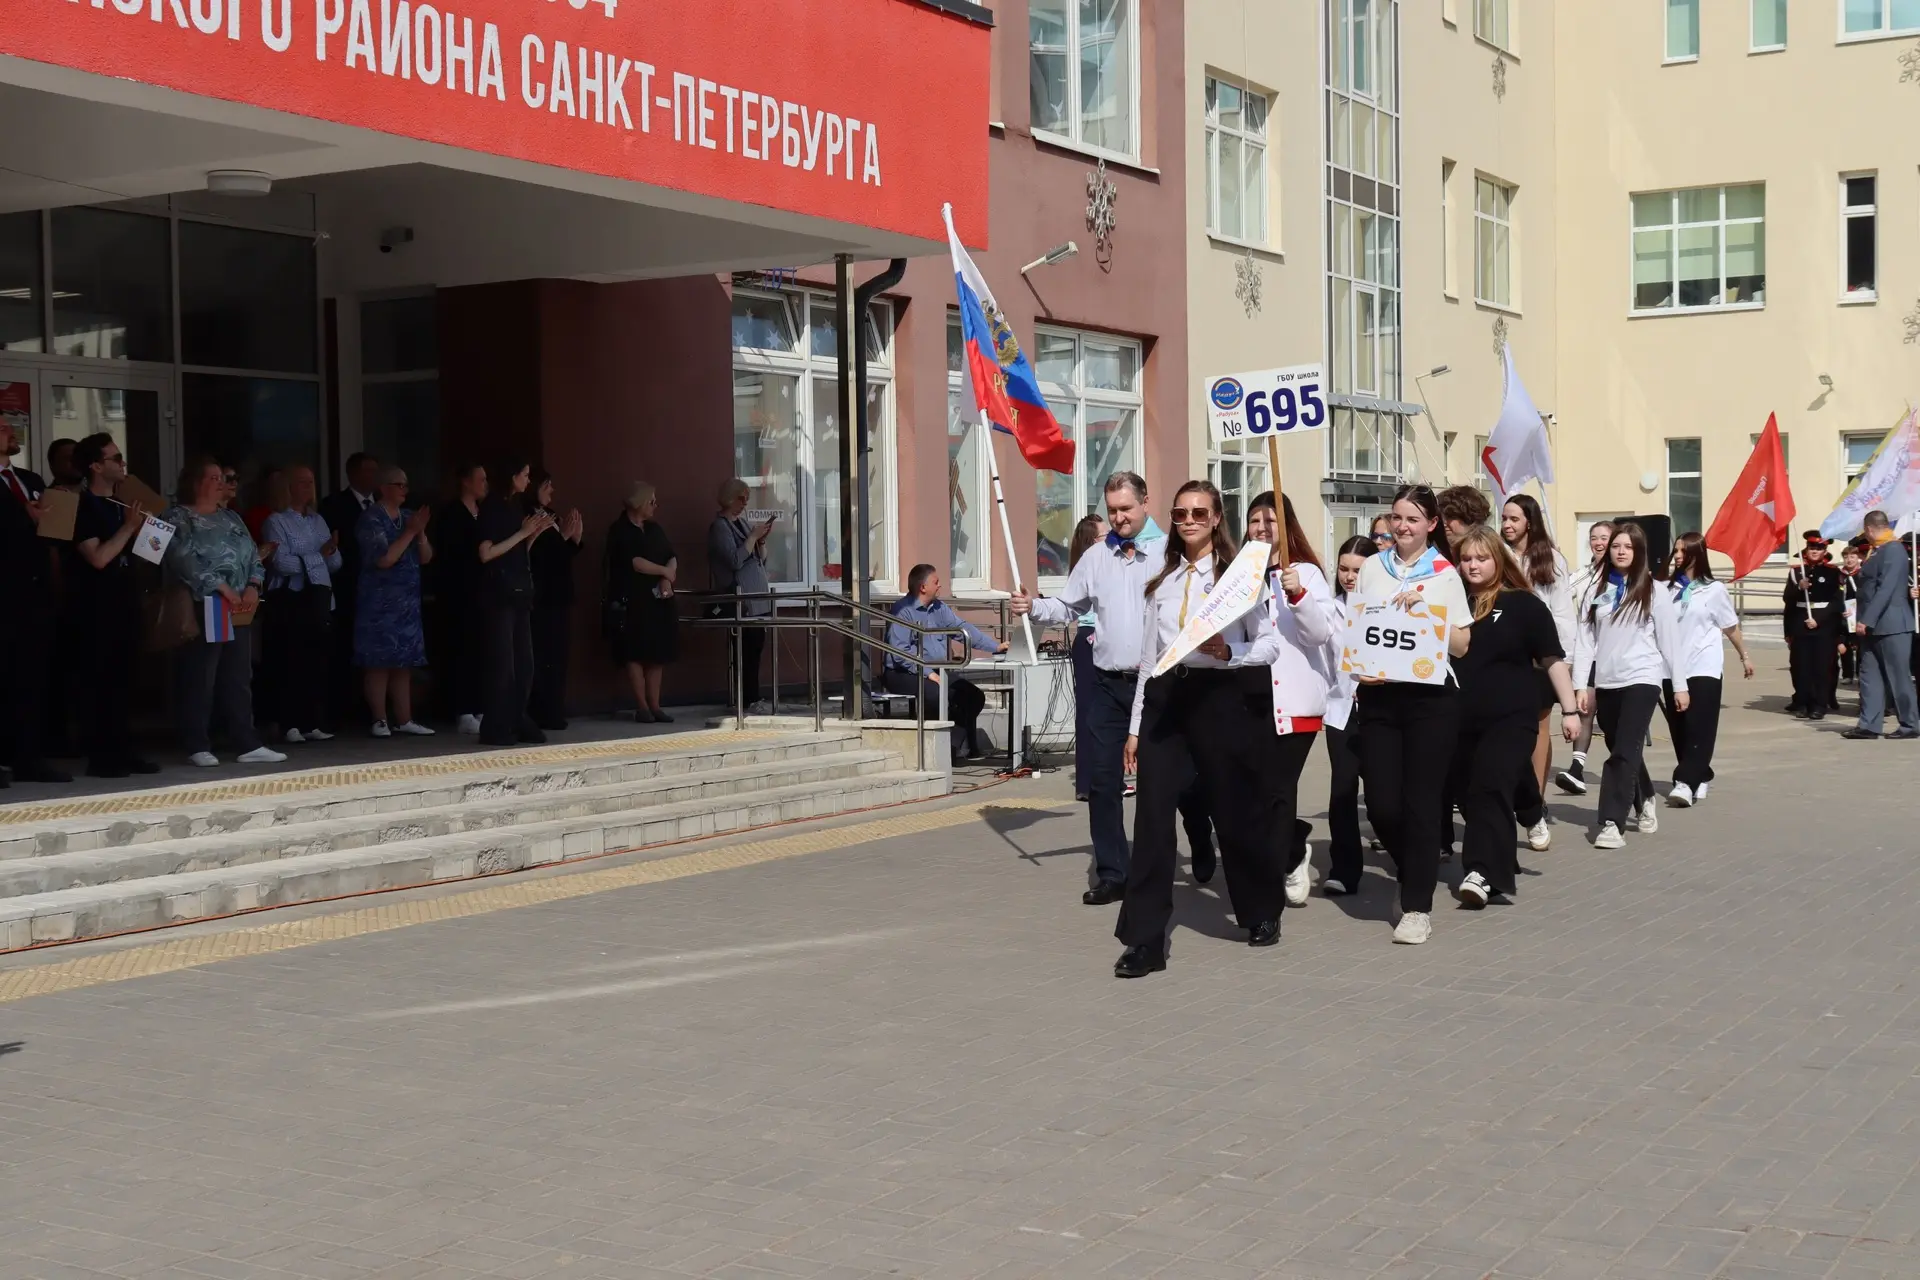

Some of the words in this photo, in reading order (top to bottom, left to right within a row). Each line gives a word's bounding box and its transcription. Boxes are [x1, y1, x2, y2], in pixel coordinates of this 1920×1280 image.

[520, 33, 882, 187] САНКТ-ПЕТЕРБУРГА
[1276, 373, 1295, 383] ГБОУ
[1297, 370, 1319, 380] школа
[1222, 418, 1243, 438] №
[1245, 384, 1325, 434] 695
[1365, 626, 1417, 651] 695
